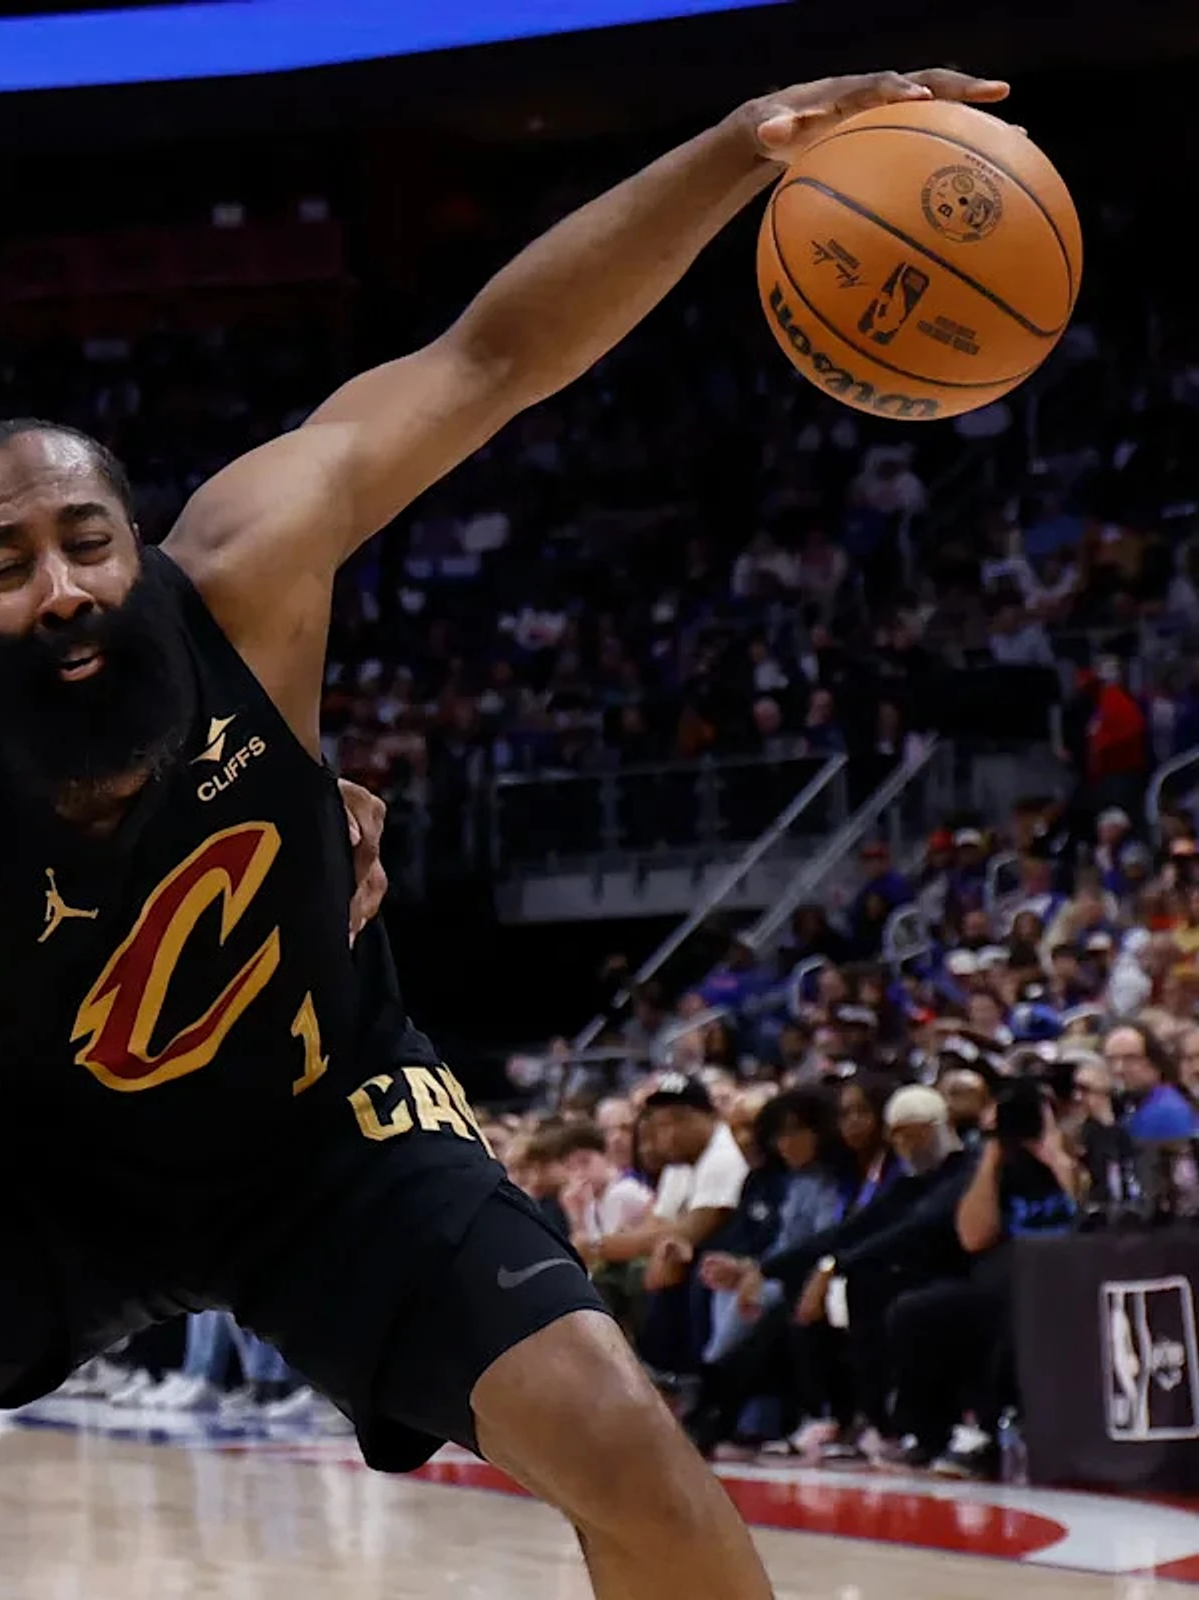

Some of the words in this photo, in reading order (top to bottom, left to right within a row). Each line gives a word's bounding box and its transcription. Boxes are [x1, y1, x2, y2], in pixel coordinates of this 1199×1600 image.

[197, 735, 267, 802] CLIFFS
[69, 820, 281, 1092] C
[291, 990, 330, 1096] 1
